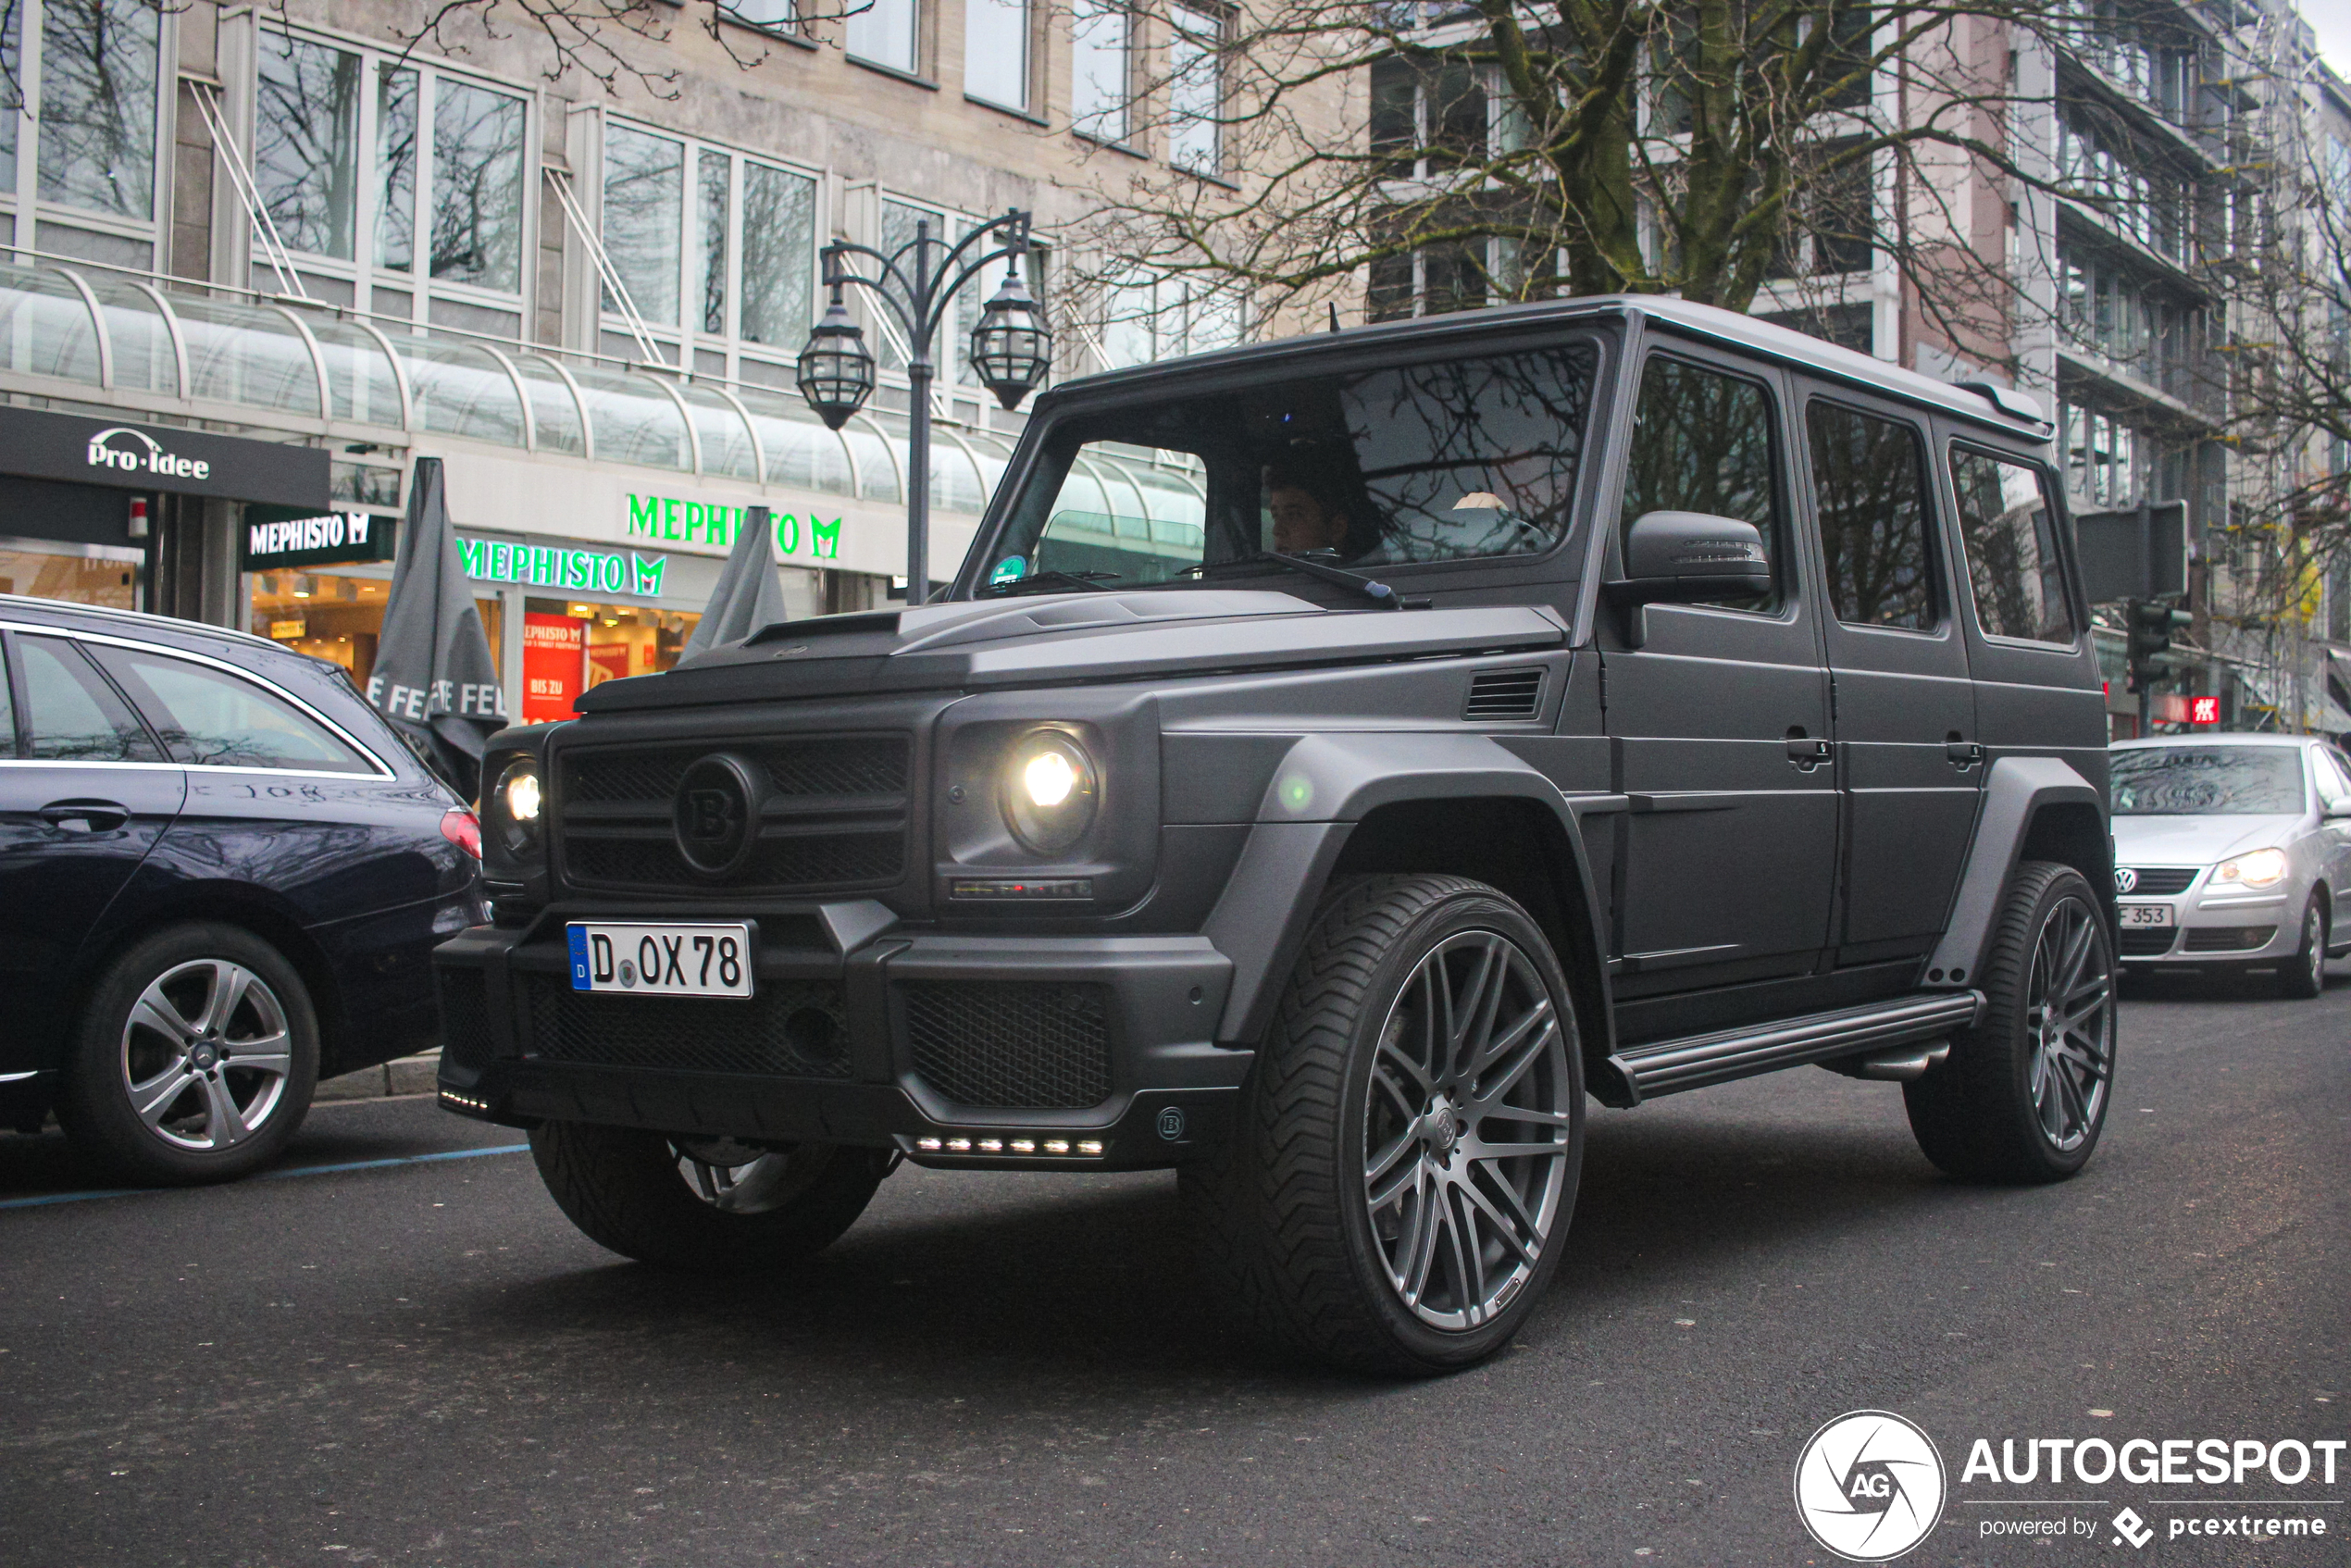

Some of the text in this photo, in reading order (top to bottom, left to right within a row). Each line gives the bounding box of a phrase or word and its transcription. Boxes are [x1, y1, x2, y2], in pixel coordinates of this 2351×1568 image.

[251, 515, 344, 555] MEPHISTO
[455, 537, 626, 593] MEPHISTO
[1005, 560, 1015, 575] 4
[530, 678, 563, 695] BIS ZU
[2133, 907, 2164, 923] 353
[591, 933, 614, 982] D
[577, 964, 586, 978] D
[1163, 1115, 1180, 1135] B
